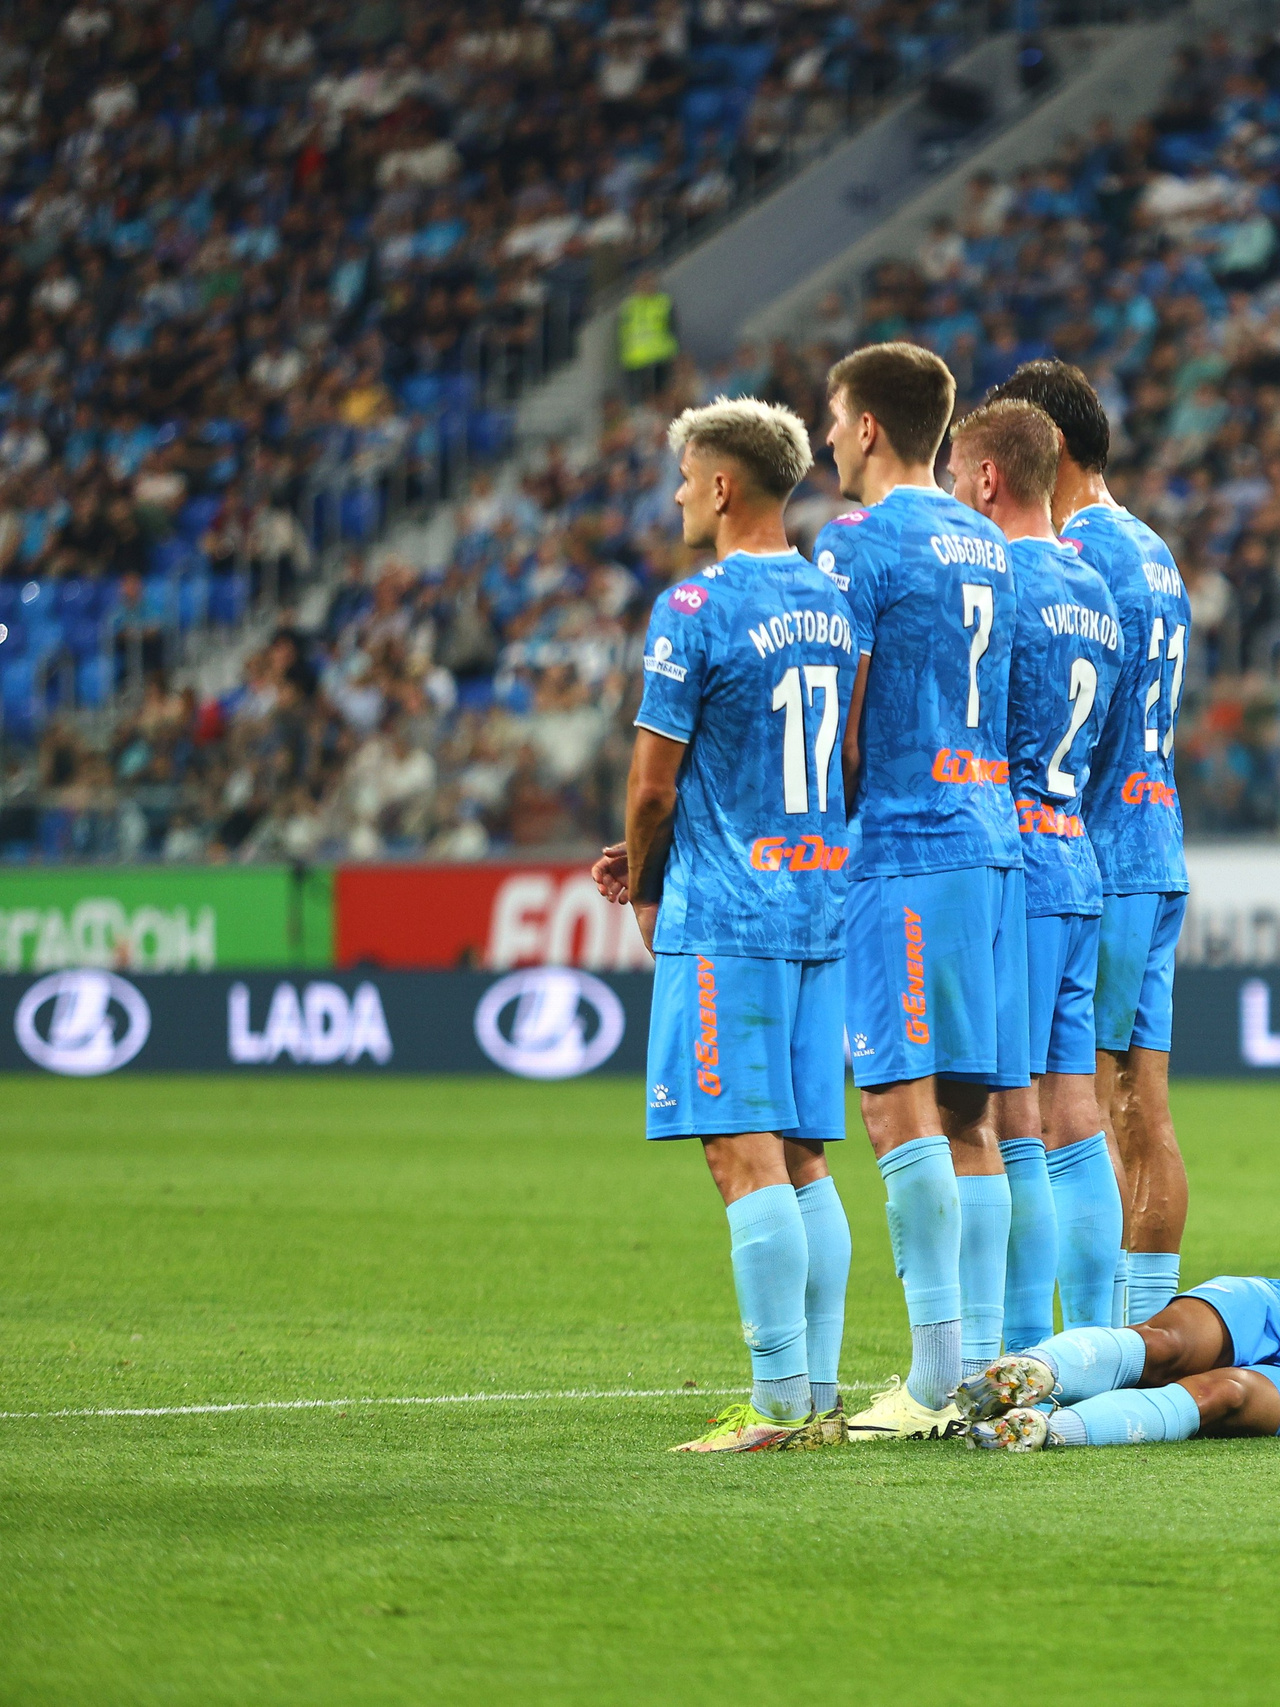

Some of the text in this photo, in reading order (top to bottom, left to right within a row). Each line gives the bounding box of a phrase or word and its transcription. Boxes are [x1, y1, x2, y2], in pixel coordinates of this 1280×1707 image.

[930, 534, 1007, 574] СОБОЛЕВ
[1142, 562, 1182, 599] РОХИН
[961, 583, 994, 728] 7
[1041, 603, 1118, 651] ЧИСТЯКОВ
[1047, 657, 1098, 798] 2
[1144, 617, 1186, 759] 21
[771, 665, 839, 815] 17
[0, 897, 214, 975] ГАФОН
[227, 981, 394, 1066] LADA
[650, 1099, 677, 1109] KELME
